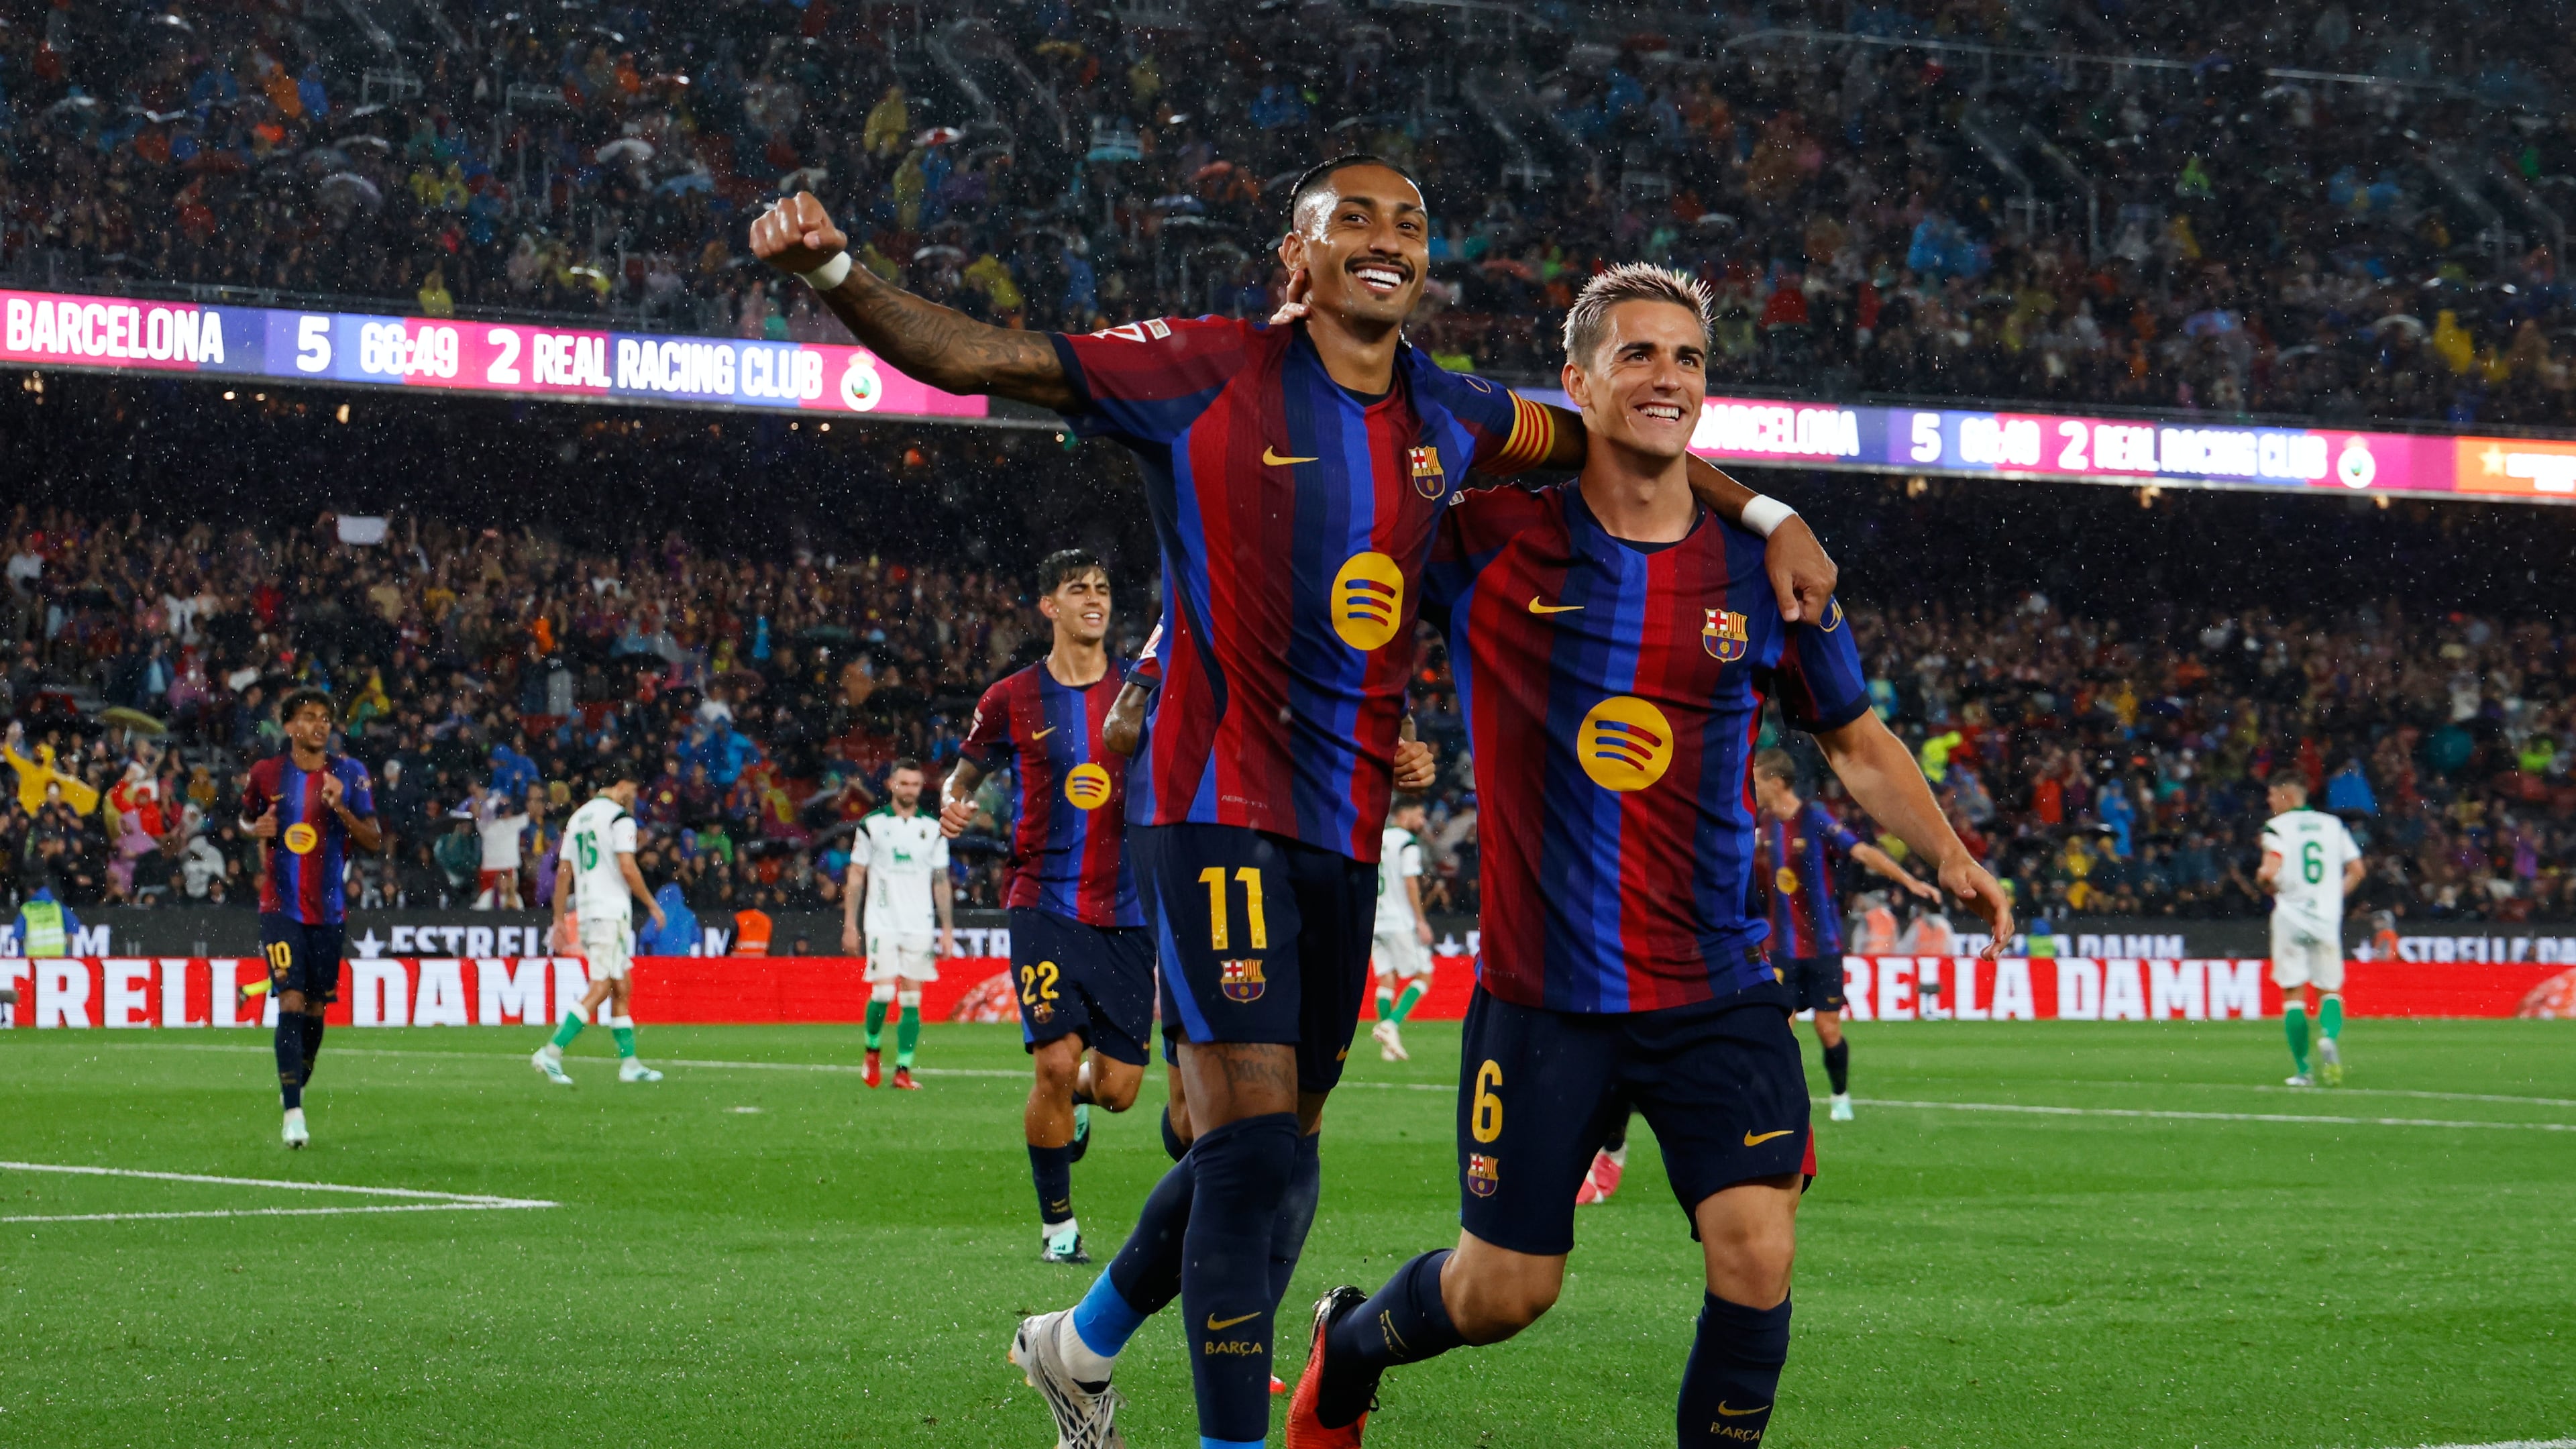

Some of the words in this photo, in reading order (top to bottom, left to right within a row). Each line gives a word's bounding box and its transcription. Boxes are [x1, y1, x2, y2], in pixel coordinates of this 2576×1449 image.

[6, 299, 225, 364] BARCELONA
[297, 316, 331, 372] 5
[360, 322, 458, 377] 66:49
[487, 329, 521, 384] 2
[533, 333, 611, 388] REAL
[618, 339, 735, 395] RACING
[741, 346, 823, 399] CLUB
[1911, 413, 1943, 463] 5
[2058, 421, 2089, 470] 2
[1717, 630, 1735, 639] FCB
[2303, 841, 2324, 884] 6
[1198, 867, 1267, 950] 11
[266, 941, 292, 970] 10
[0, 959, 280, 1028] TRELL
[347, 957, 612, 1027] DAMM
[1021, 961, 1060, 1006] 22
[2057, 959, 2261, 1020] DAMM
[1472, 1059, 1503, 1143] 6
[1205, 1341, 1263, 1356] BARÇA
[1711, 1421, 1760, 1442] BARÇA
